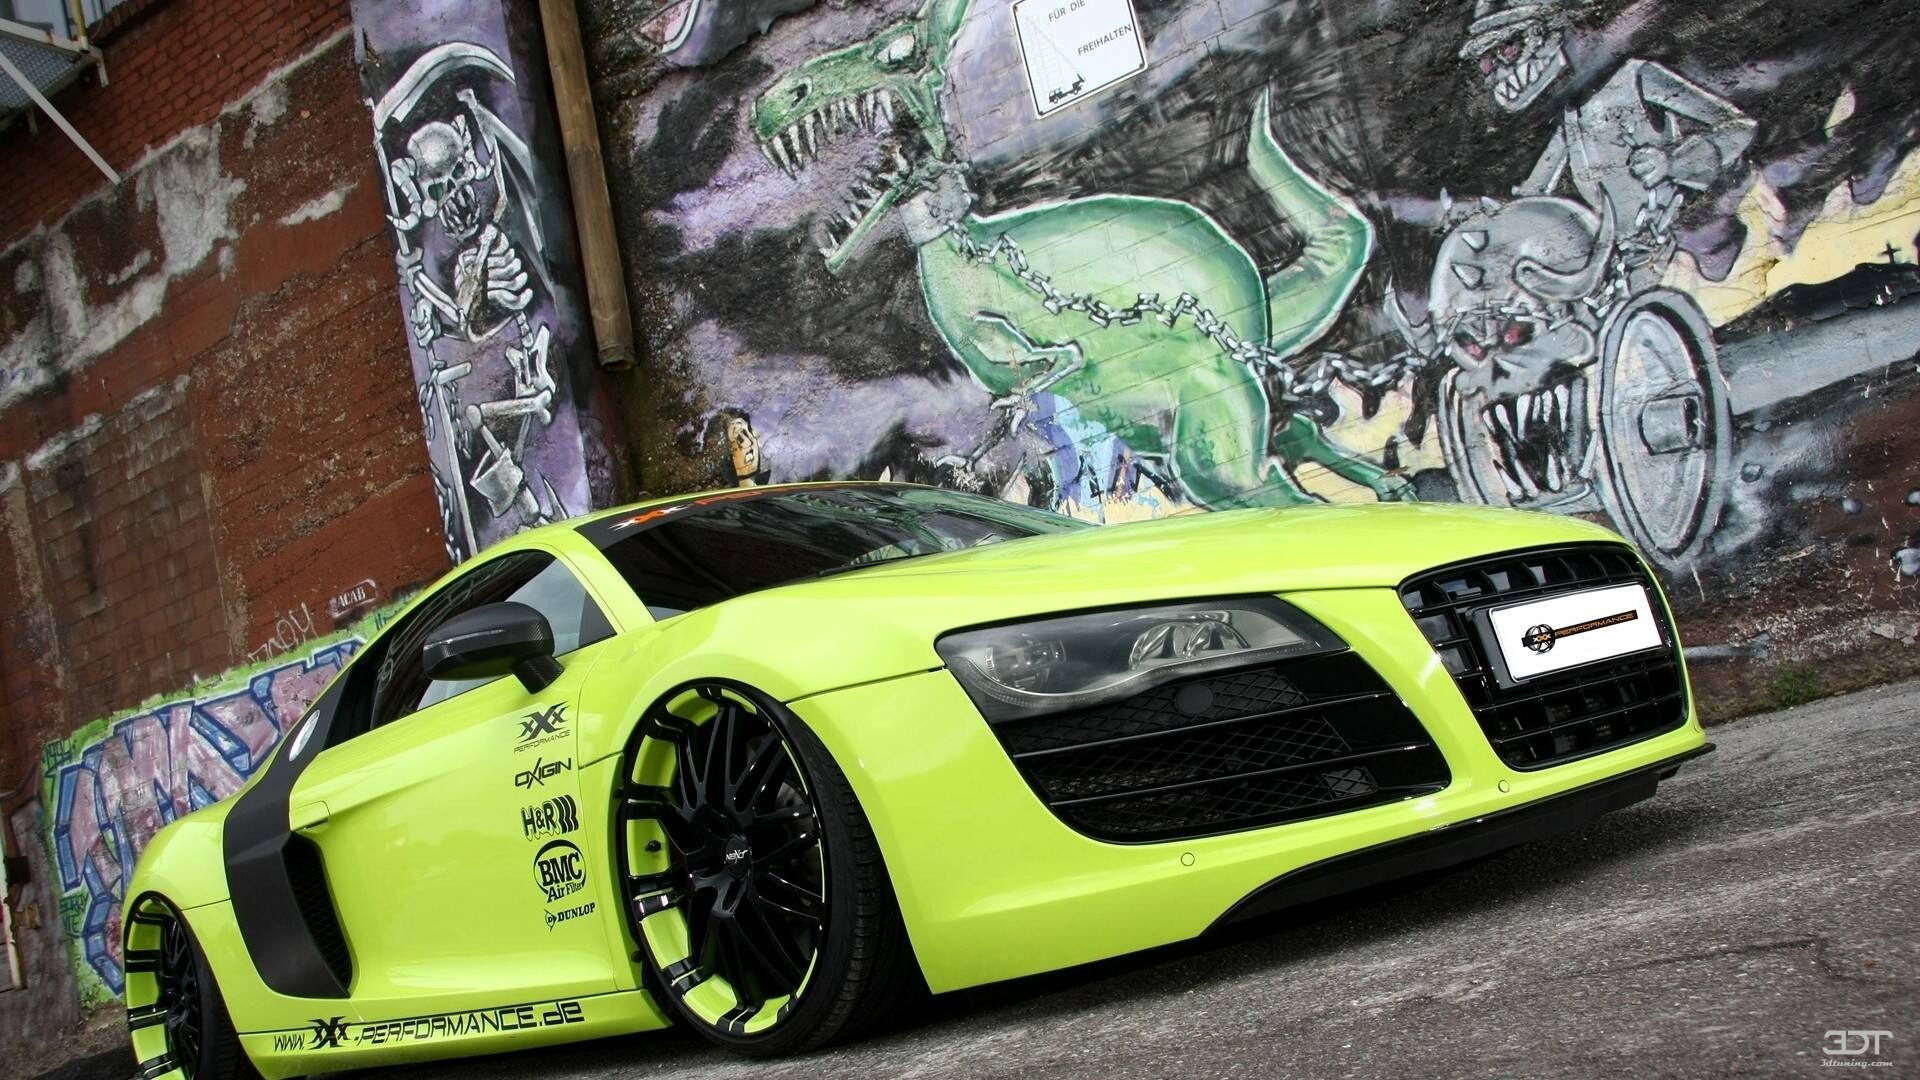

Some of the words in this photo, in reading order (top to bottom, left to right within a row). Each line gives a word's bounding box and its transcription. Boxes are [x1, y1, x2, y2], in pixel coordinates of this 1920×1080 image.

[1048, 7, 1066, 22] FÜR
[1070, 0, 1086, 11] DIE
[1077, 23, 1132, 56] FREIHALTEN
[1553, 612, 1635, 638] PERFORMANCE
[513, 729, 571, 754] PERFORMANCE
[515, 757, 572, 790] OXIGIN
[521, 801, 558, 838] H&R
[537, 851, 583, 888] BMC
[547, 884, 566, 904] Air
[557, 902, 596, 922] DUNLOP
